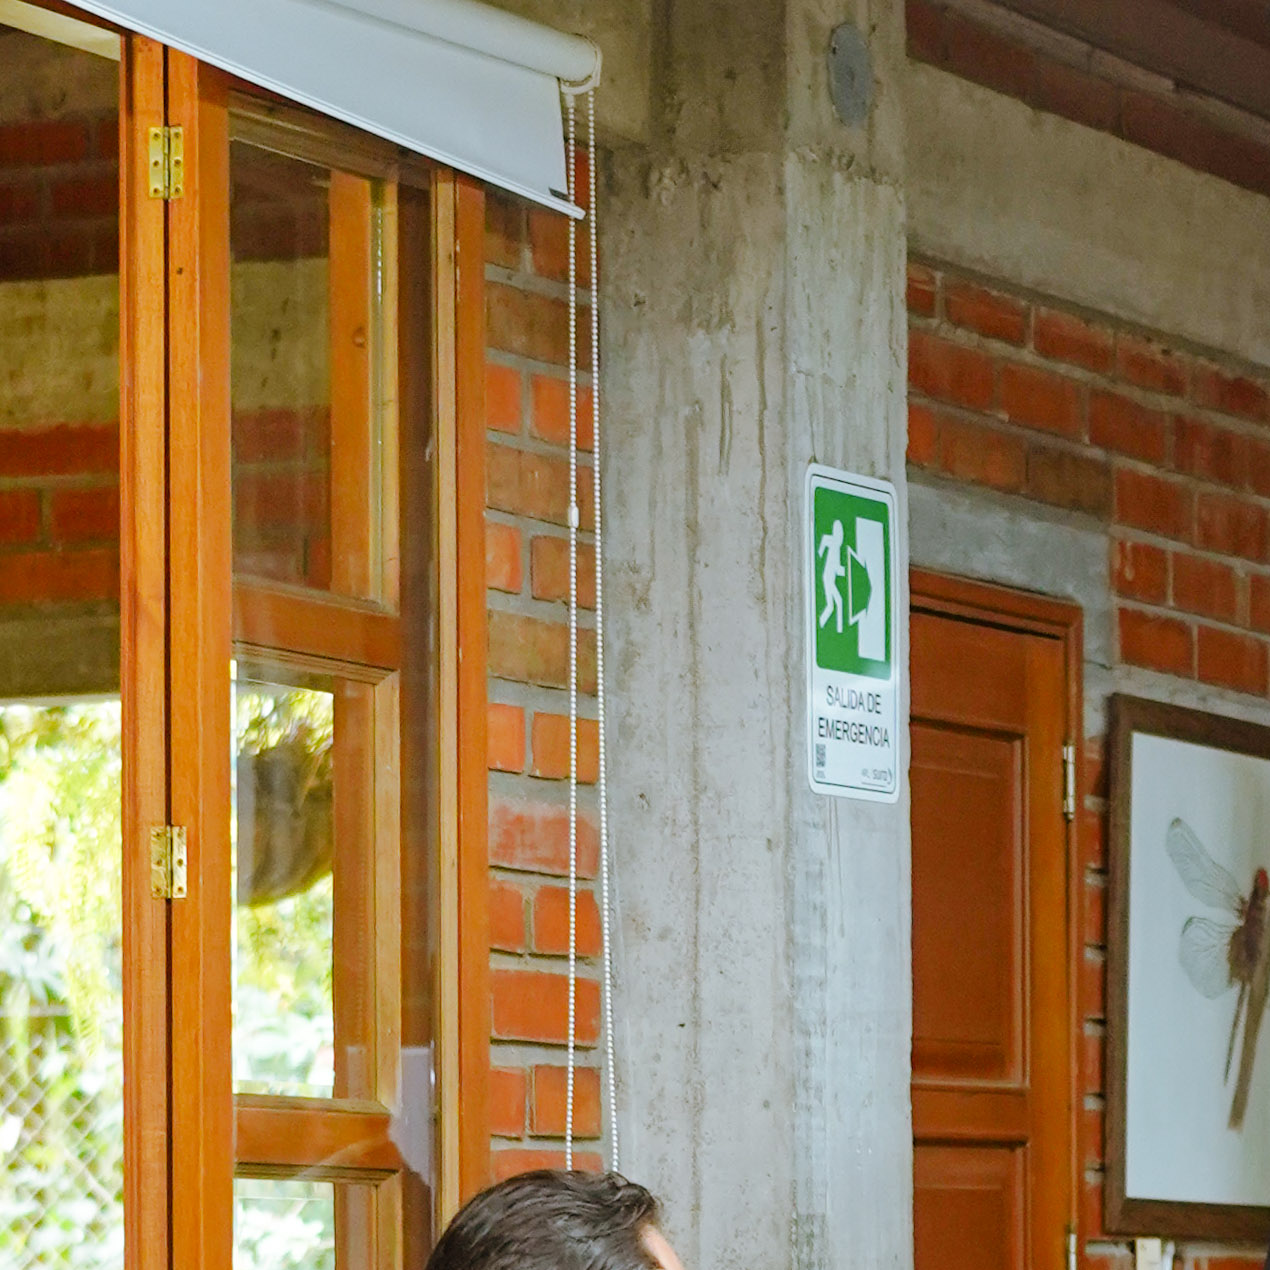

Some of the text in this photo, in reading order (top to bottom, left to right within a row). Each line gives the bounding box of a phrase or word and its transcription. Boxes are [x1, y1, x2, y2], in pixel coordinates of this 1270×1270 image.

[826, 685, 881, 715] SALIDA DE
[818, 717, 890, 748] EMERGENCIA
